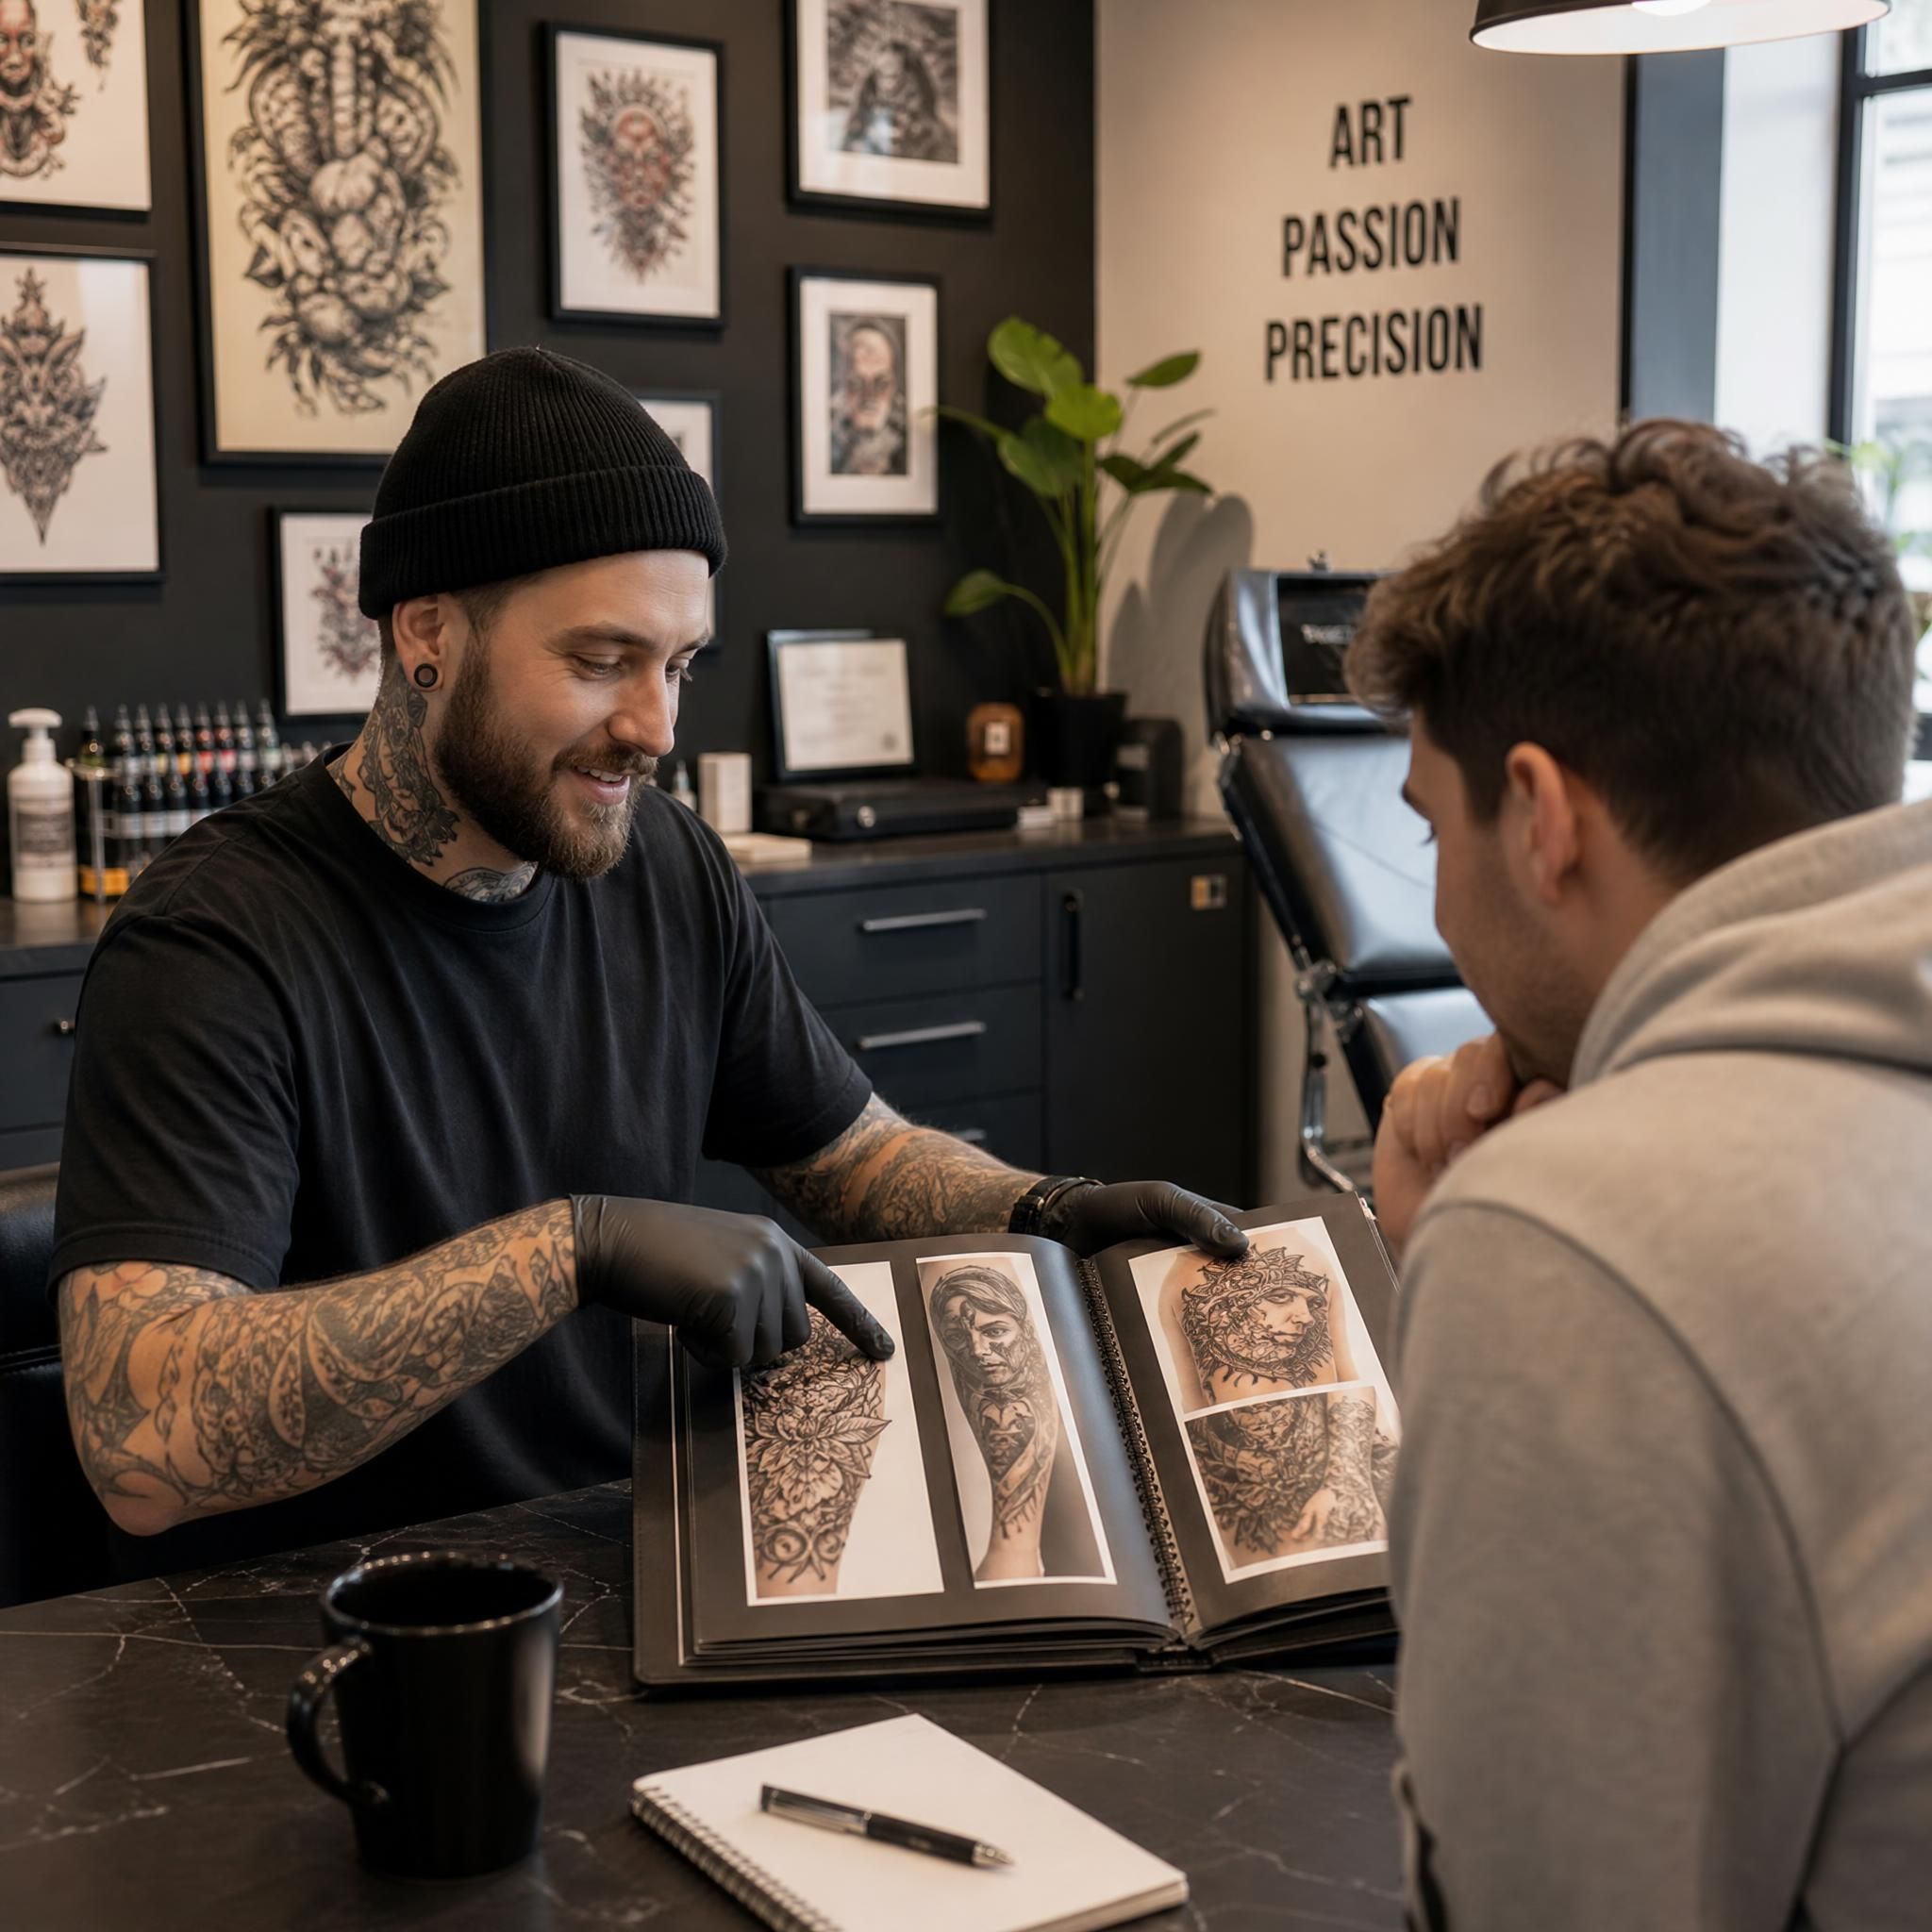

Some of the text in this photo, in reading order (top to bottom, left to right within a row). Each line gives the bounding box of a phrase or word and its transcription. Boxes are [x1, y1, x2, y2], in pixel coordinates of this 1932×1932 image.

[1330, 95, 1411, 168] ART
[1282, 196, 1459, 277] PASSION
[1265, 304, 1483, 382] PRECISION
